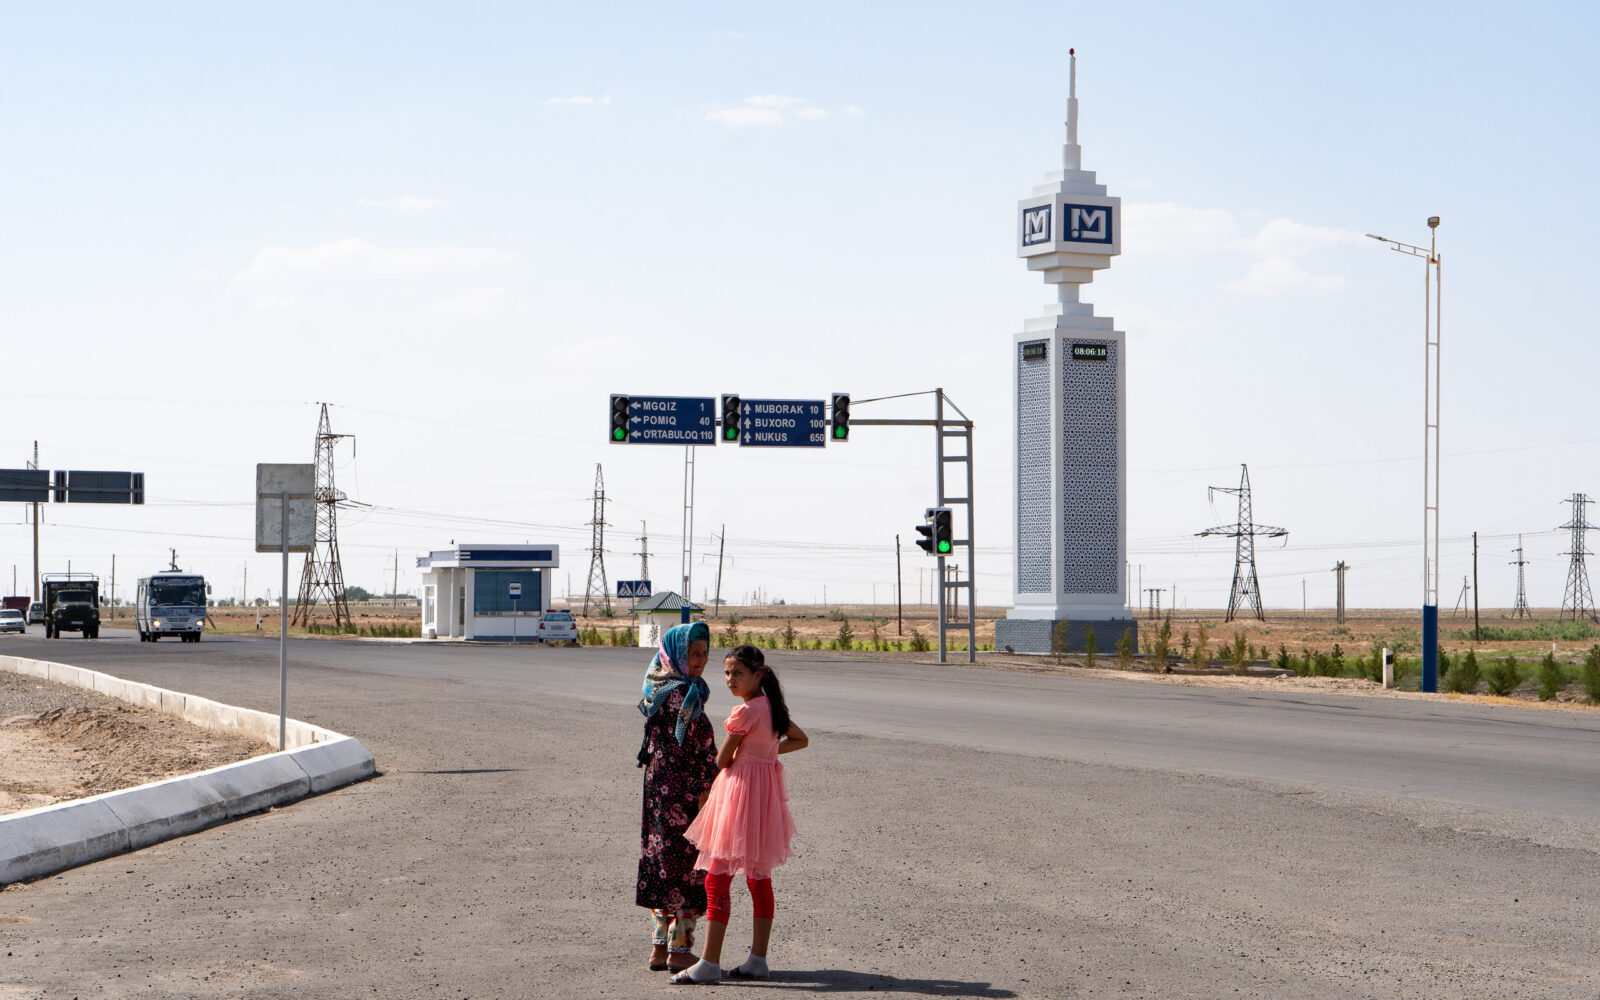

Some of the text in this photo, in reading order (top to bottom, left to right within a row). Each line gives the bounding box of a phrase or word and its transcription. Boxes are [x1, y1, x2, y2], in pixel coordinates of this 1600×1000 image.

[1074, 347, 1106, 356] 08:06:18
[643, 401, 705, 411] MGQIZ 1
[754, 404, 819, 414] MUBORAK 10
[643, 415, 710, 426] POMIQ 40
[754, 418, 824, 428] BUXORO 100
[700, 430, 713, 440] 110
[754, 432, 825, 442] NUKUS 650
